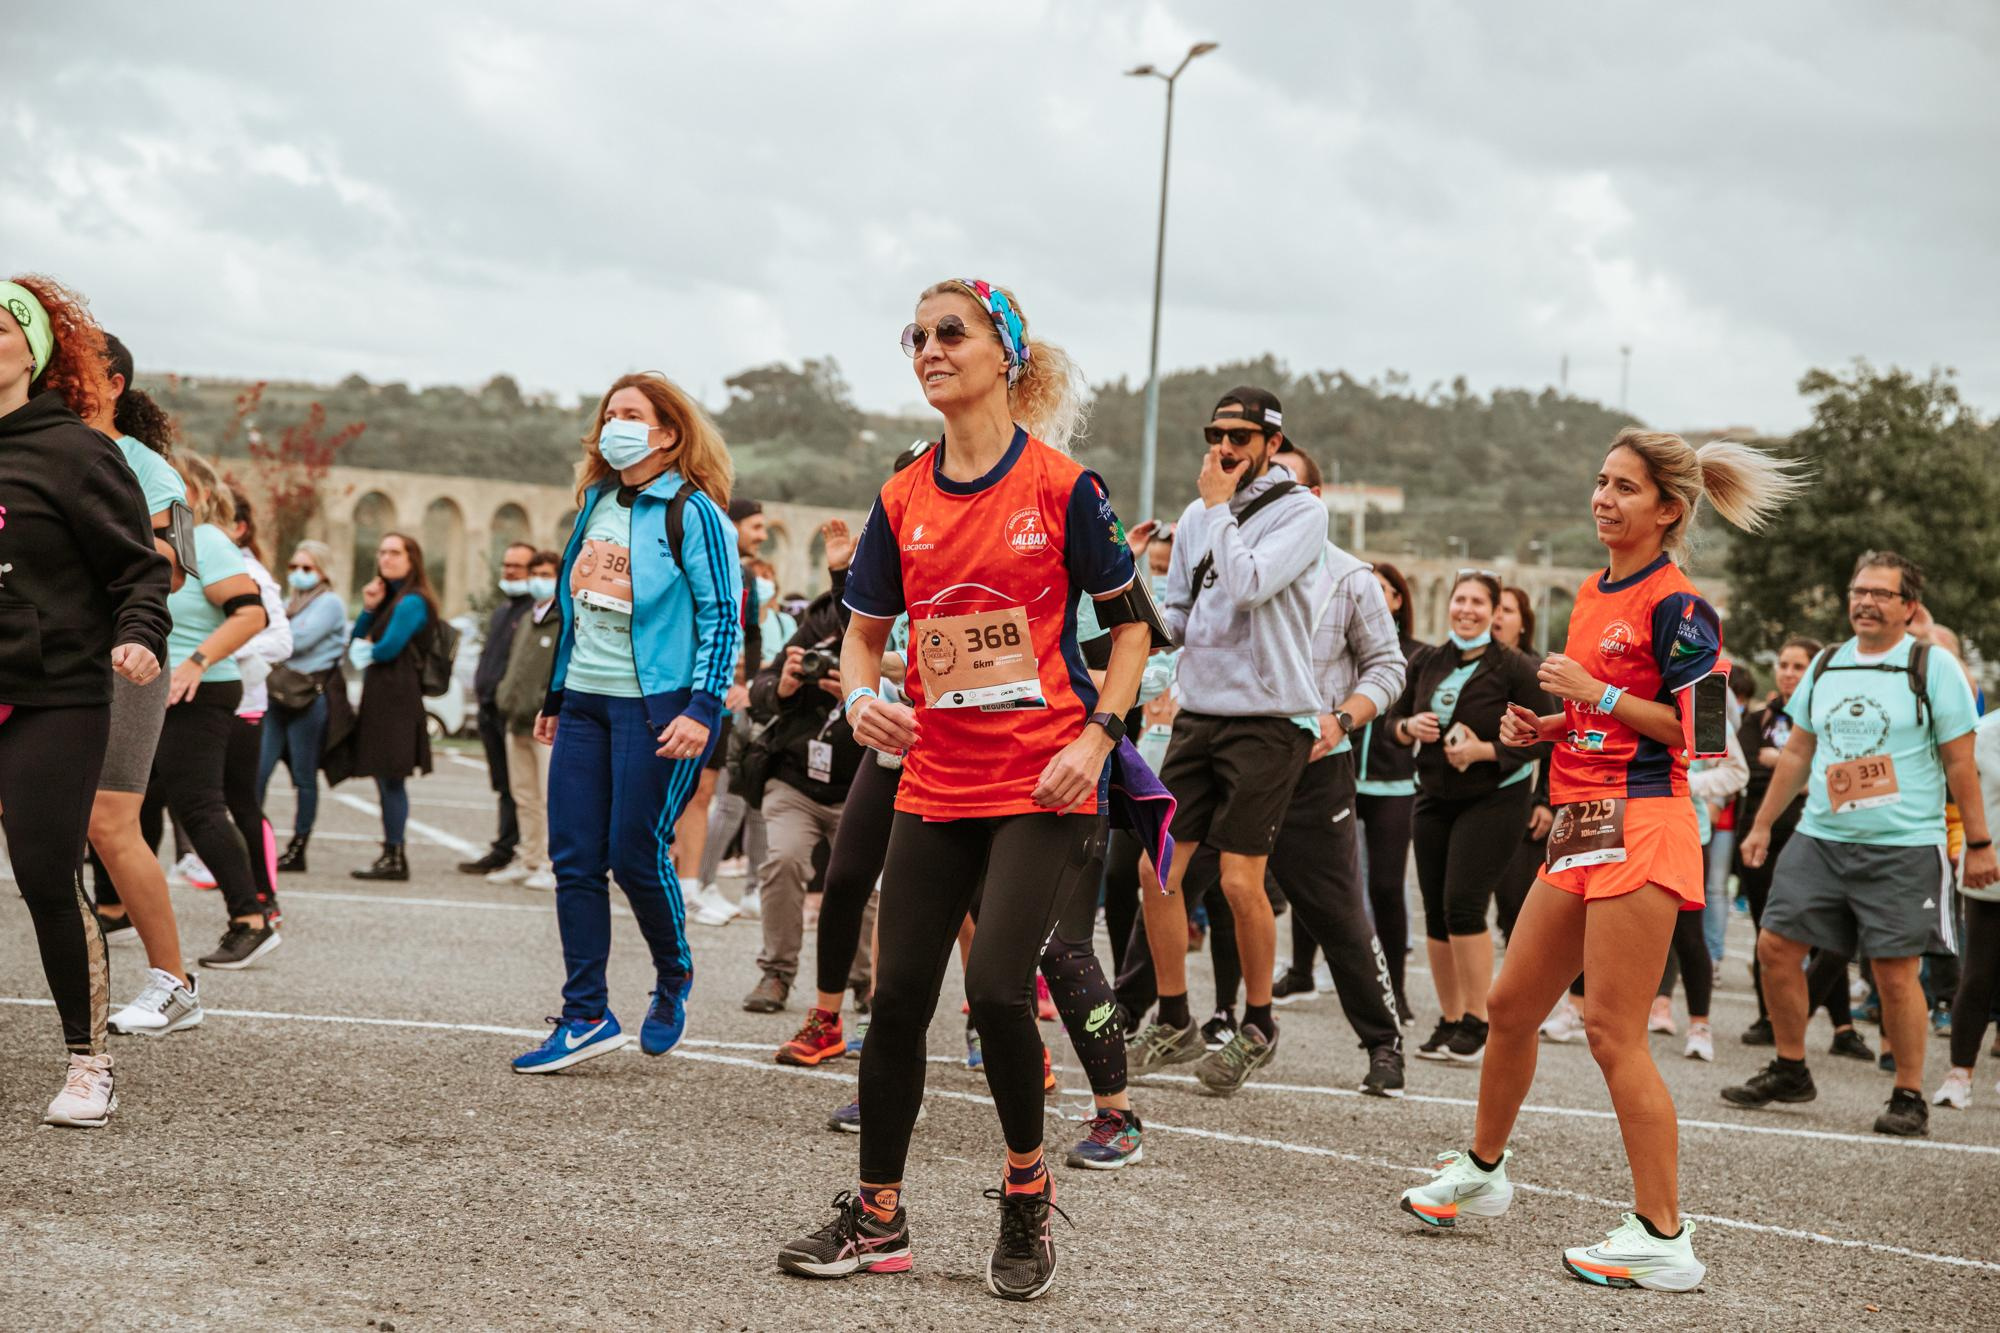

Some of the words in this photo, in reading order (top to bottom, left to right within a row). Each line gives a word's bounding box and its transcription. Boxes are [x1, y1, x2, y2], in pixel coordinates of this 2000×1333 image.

[903, 543, 934, 551] Lacatoni
[965, 622, 1021, 653] 368
[973, 660, 994, 669] 6km
[981, 701, 1016, 711] SEGUROS
[1858, 762, 1887, 780] 331
[1579, 798, 1616, 824] 229
[1089, 1002, 1111, 1023] NIKE
[1094, 1023, 1119, 1039] AIR
